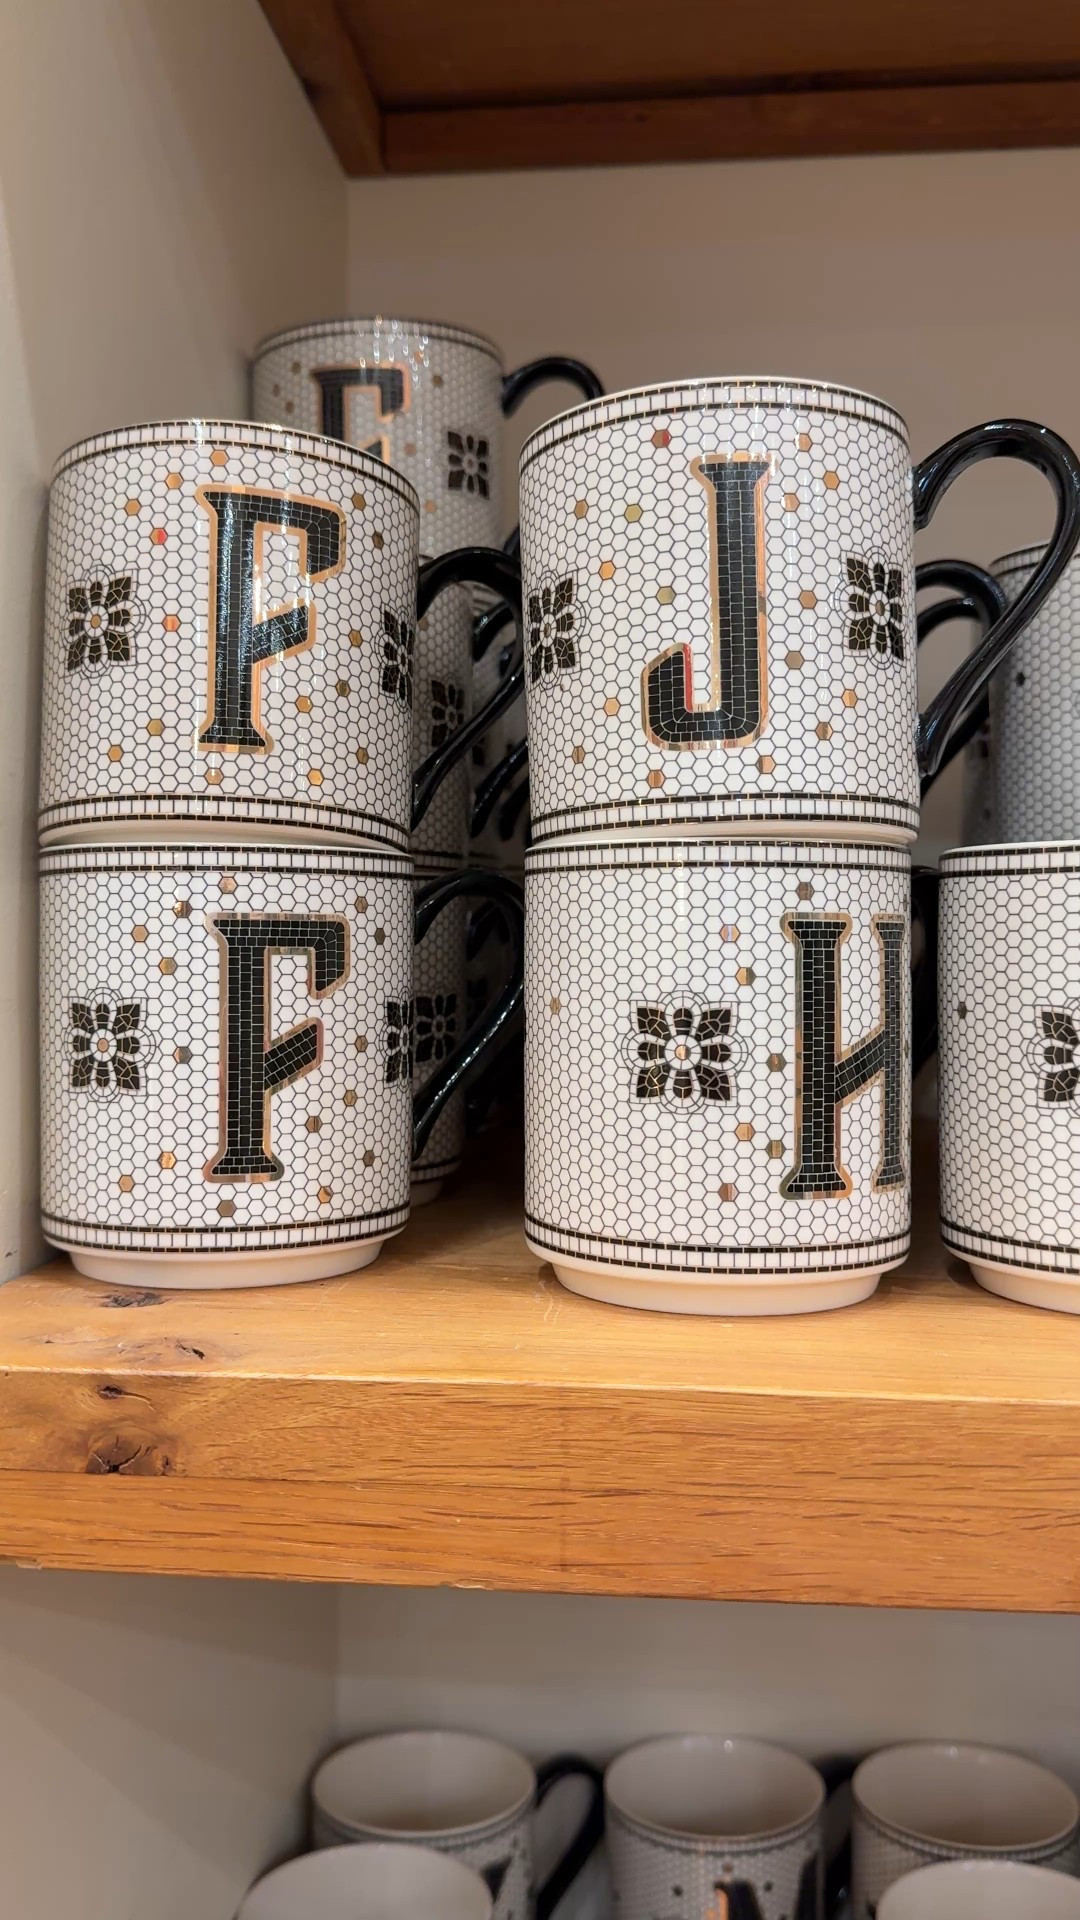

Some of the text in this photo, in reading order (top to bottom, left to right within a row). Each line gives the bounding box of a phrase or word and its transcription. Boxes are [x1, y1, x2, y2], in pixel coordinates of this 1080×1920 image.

[195, 484, 346, 754] F
[640, 453, 778, 750] J
[203, 912, 350, 1183] F
[779, 912, 905, 1199] H
